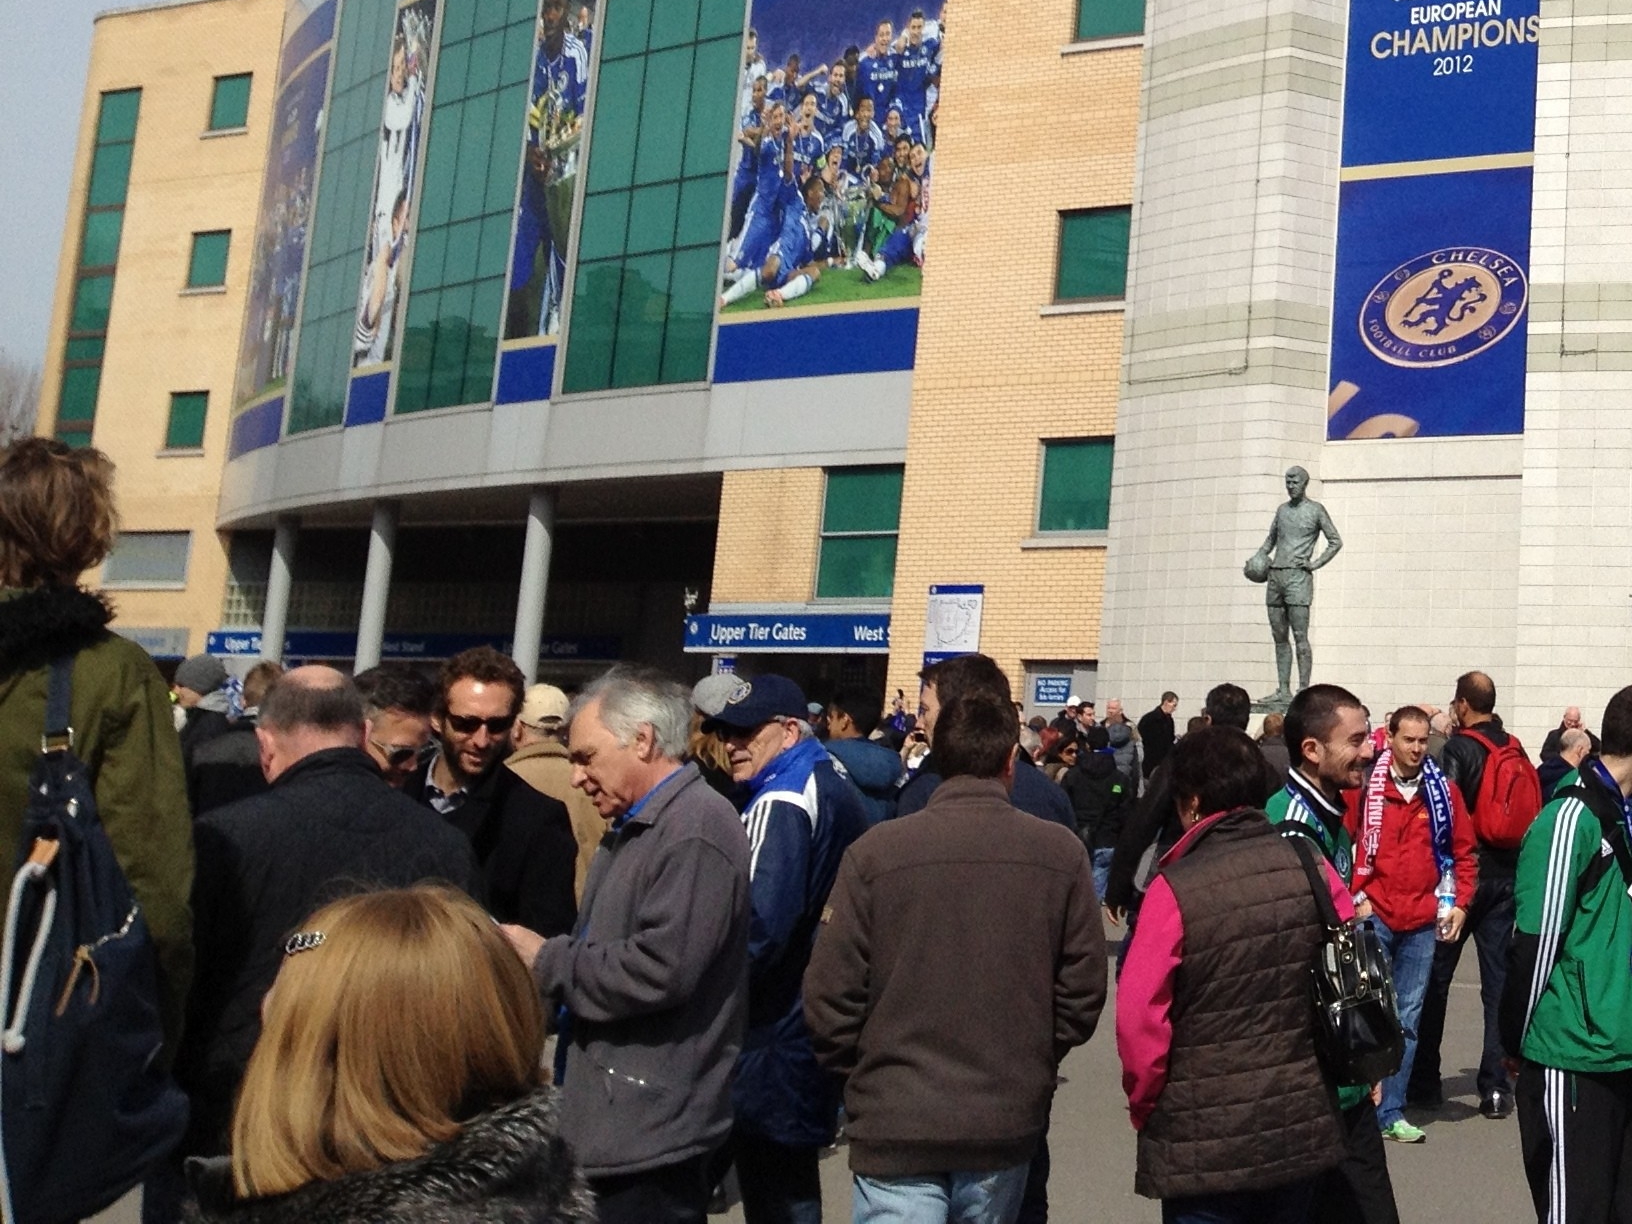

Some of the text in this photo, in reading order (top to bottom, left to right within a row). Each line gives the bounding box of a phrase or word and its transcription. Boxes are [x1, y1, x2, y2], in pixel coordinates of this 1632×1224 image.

[1370, 15, 1540, 59] CHAMPIONS
[1433, 54, 1473, 76] 2012
[1431, 250, 1520, 287] CHELSEA
[1368, 318, 1458, 358] FOOTBALL CLUB
[710, 623, 745, 645] Upper
[748, 622, 771, 640] Tier
[772, 622, 807, 641] Gates
[853, 625, 884, 642] West
